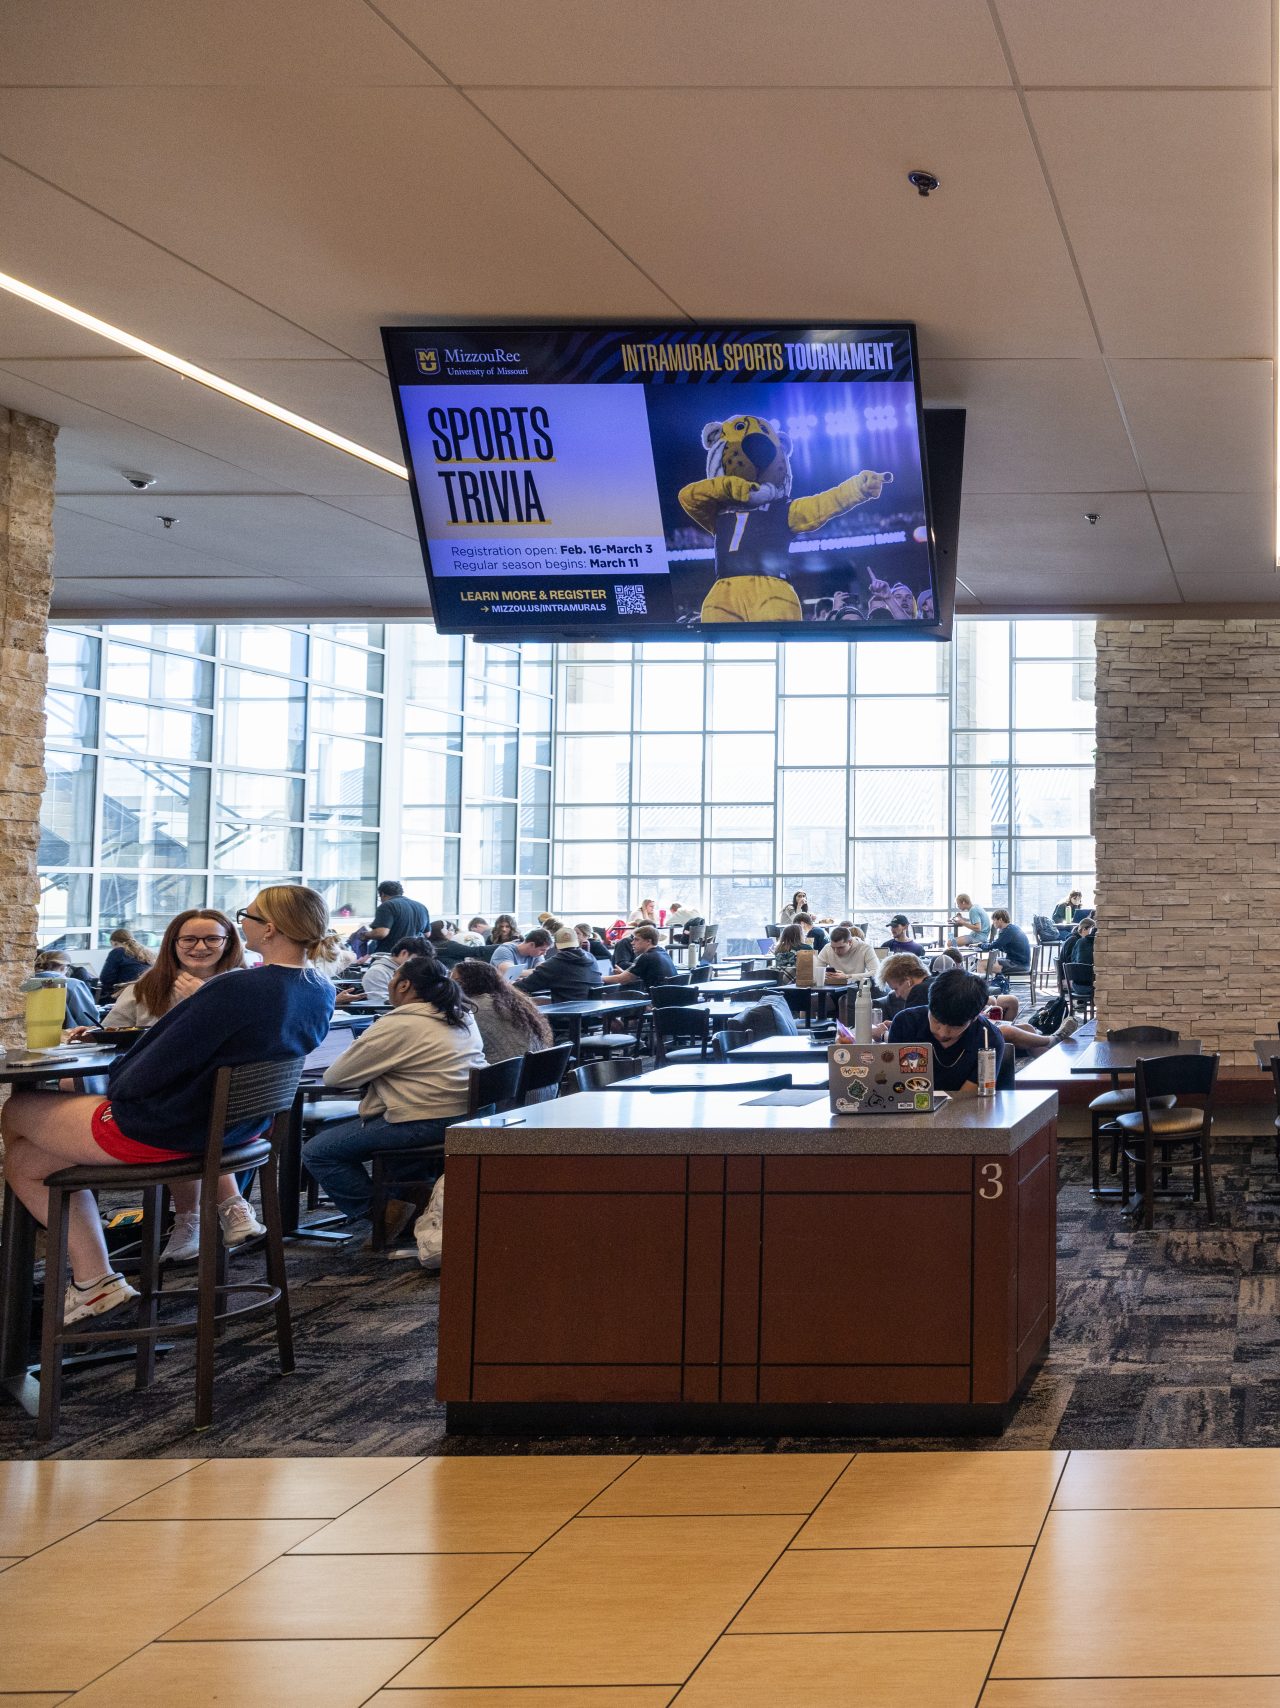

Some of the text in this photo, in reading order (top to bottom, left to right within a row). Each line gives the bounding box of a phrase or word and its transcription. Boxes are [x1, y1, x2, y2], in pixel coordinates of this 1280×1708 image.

[444, 348, 521, 363] MizzouRec
[621, 342, 894, 372] INTRAMURAL SPORTS TOURNAMENT
[447, 367, 529, 377] University of Missouri
[427, 406, 554, 462] SPORTS
[438, 469, 546, 524] TRIVIA
[451, 544, 653, 558] Registration open: Feb. 16-March 3
[453, 558, 639, 572] Regular season begins: March 11
[460, 589, 607, 602] LEARN MORE & REGISTER
[491, 603, 607, 613] MIZZOU.US/INTRAMURALS
[978, 1163, 1003, 1200] 3
